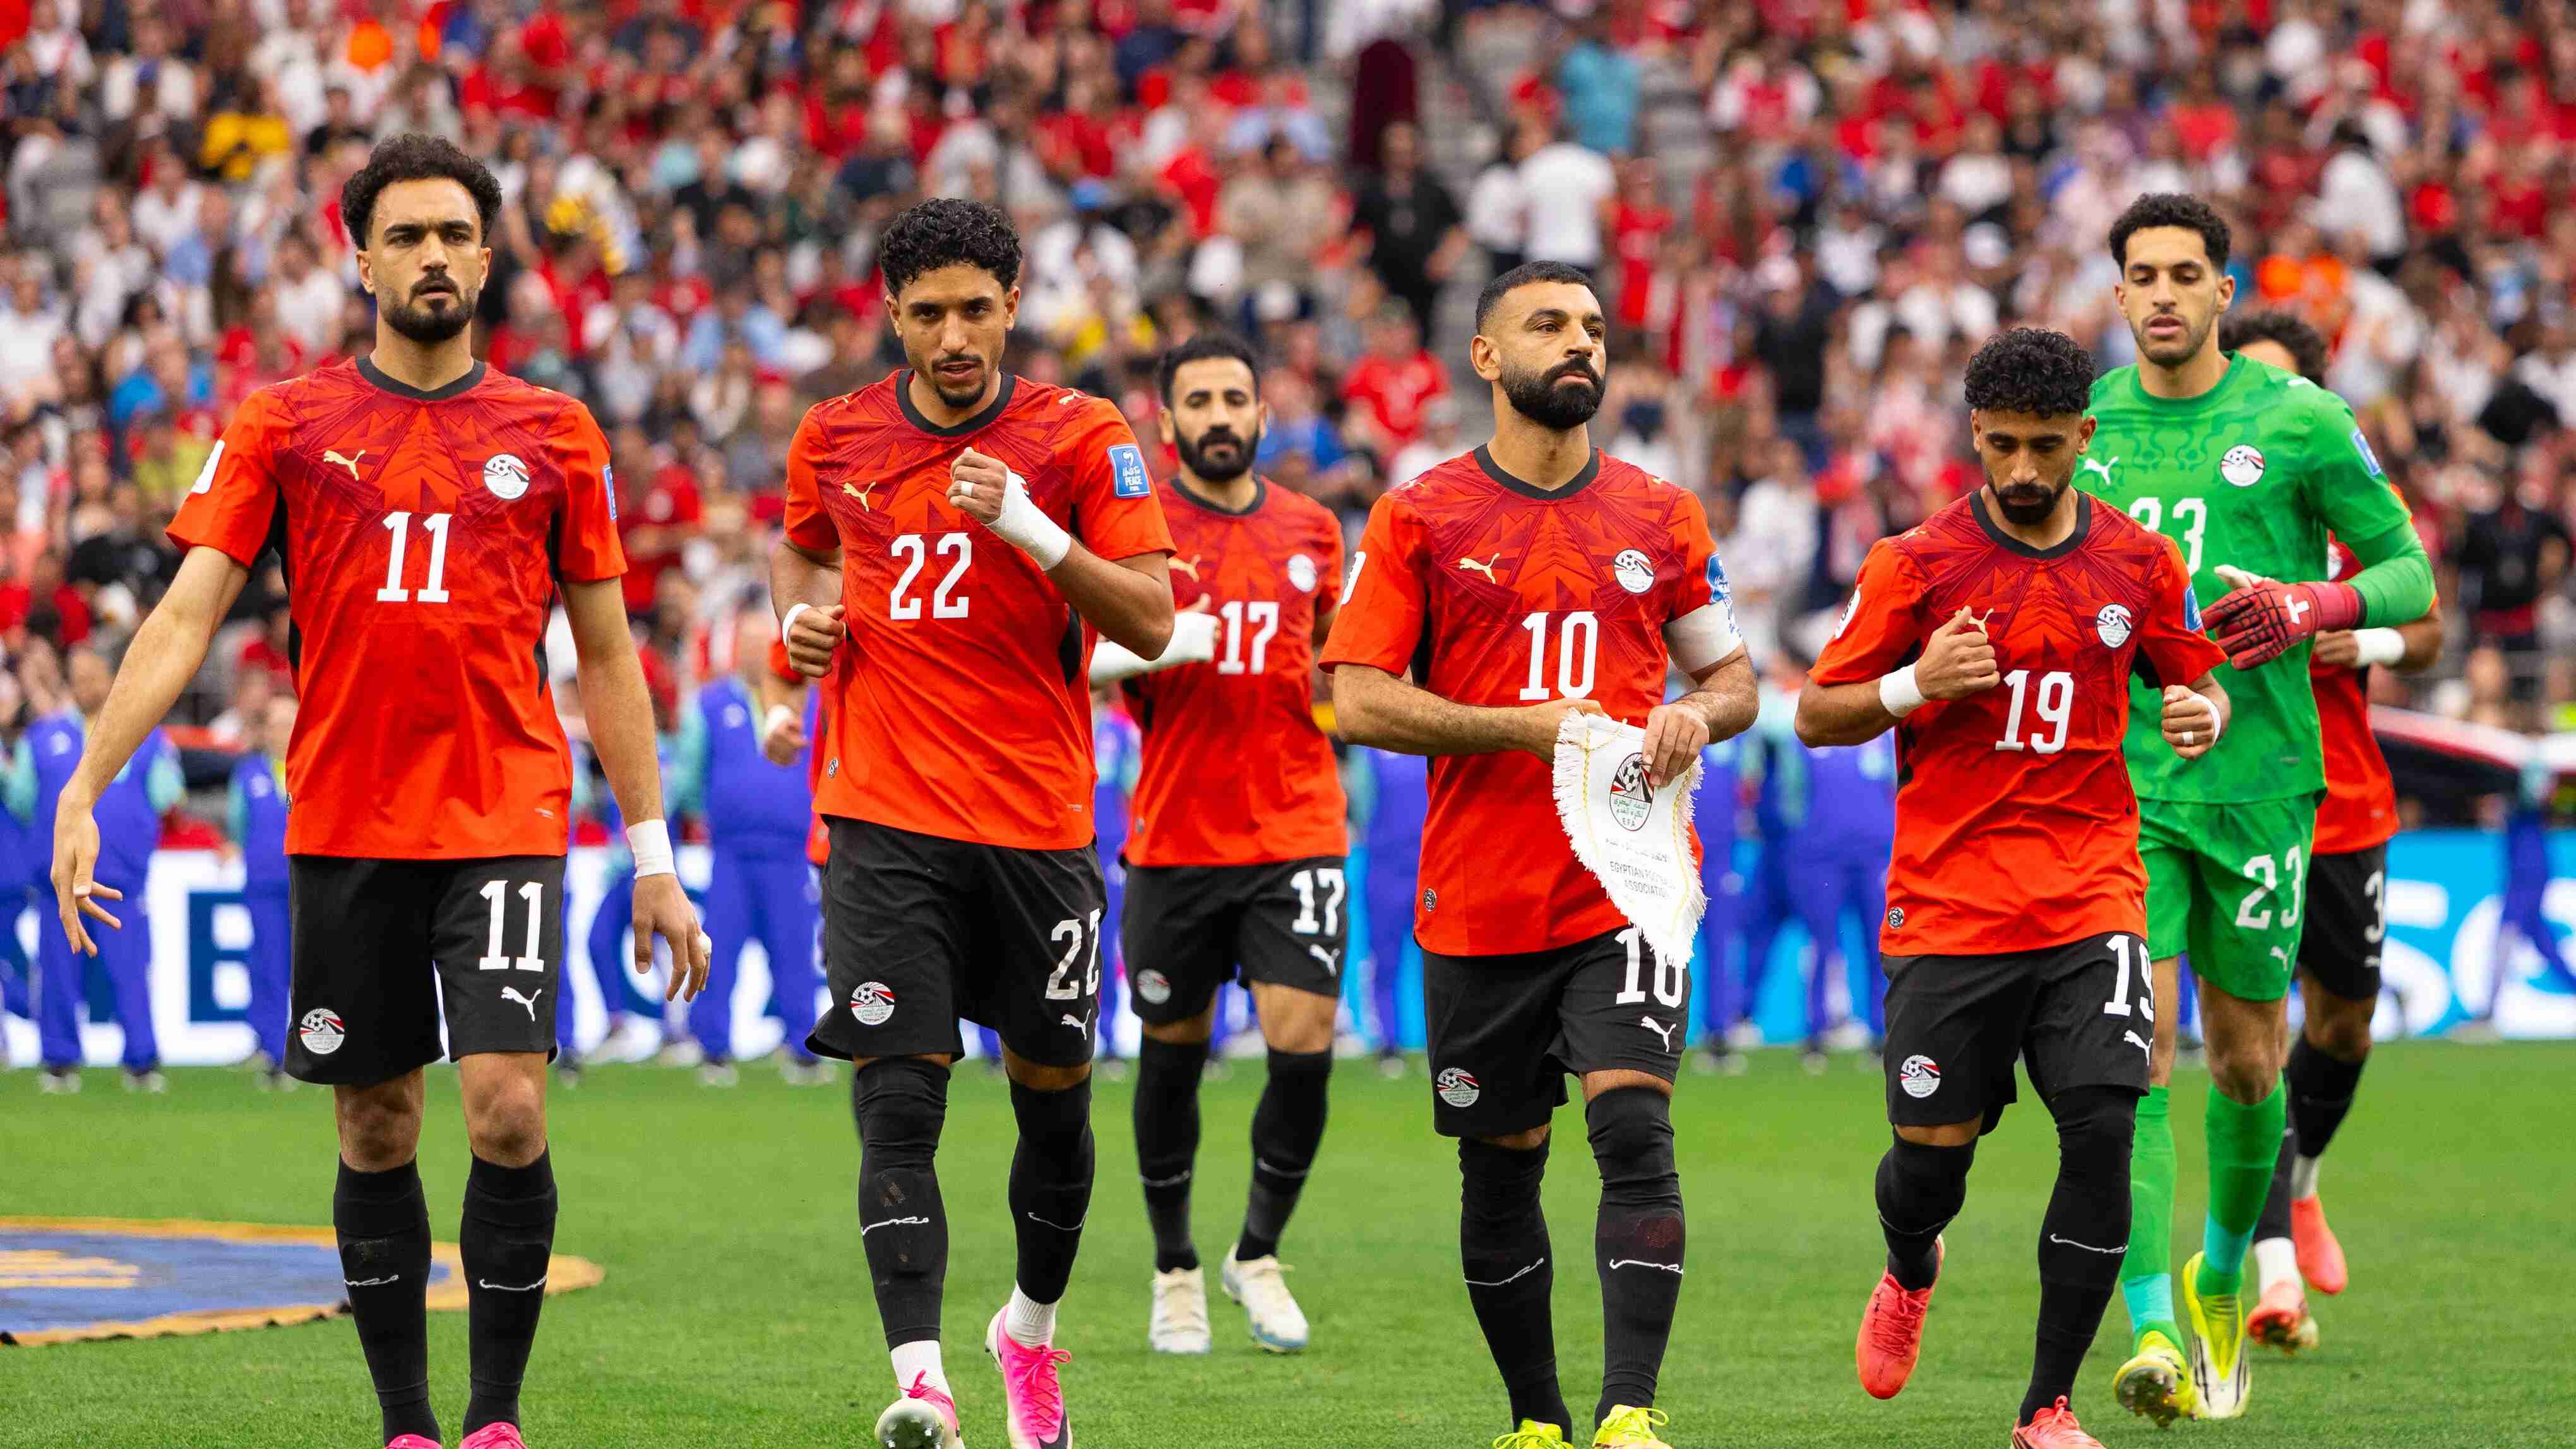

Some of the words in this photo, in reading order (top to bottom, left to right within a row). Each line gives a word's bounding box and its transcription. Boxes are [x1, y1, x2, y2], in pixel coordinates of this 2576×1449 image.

[377, 511, 452, 602] 11
[890, 532, 972, 620] 22
[1217, 601, 1279, 674] 17
[1519, 611, 1598, 700] 10
[1995, 670, 2074, 754] 19
[1291, 868, 1345, 936] 17
[1610, 861, 1644, 878] EGYPTIAN
[2235, 845, 2303, 929] 23
[479, 880, 544, 972] 11
[1045, 908, 1101, 999] 22
[1615, 927, 1685, 1009] 10
[2104, 934, 2154, 1023] 19
